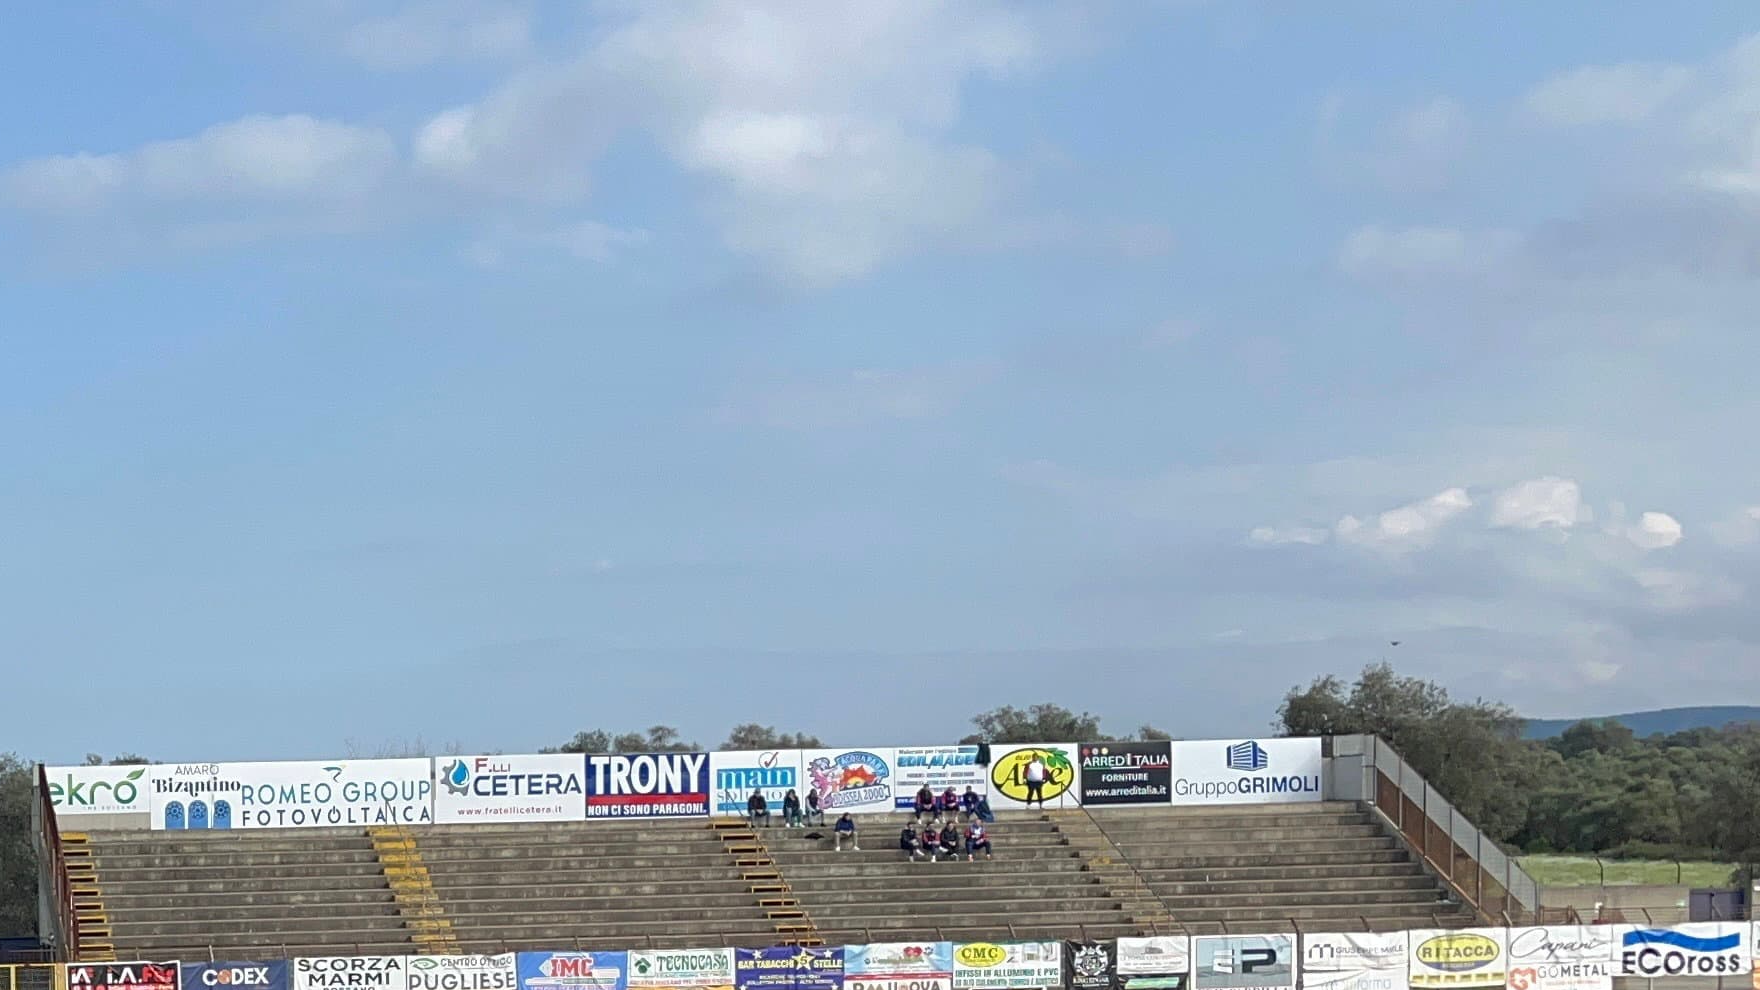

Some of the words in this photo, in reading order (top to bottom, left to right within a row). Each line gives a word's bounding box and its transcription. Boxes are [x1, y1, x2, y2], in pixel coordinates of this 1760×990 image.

[175, 765, 219, 775] AMARO
[590, 754, 706, 795] TRONY
[473, 773, 582, 796] CETERA
[718, 769, 793, 790] main
[1101, 773, 1149, 783] FORNITURE
[152, 777, 240, 797] Bizantino
[242, 782, 331, 804] ROMEO
[343, 781, 431, 803] GROUP
[1085, 786, 1167, 797] www.arreditalia.it
[243, 806, 431, 827] FOTOVOLTAICA
[588, 805, 608, 816] NON
[611, 805, 621, 816] CI
[623, 804, 651, 815] SONO
[961, 948, 998, 959] CMC
[1422, 945, 1494, 959] RITACCA
[298, 958, 401, 972] SCORZA
[440, 957, 478, 967] CENTRO
[656, 954, 728, 971] TECNOCASA
[738, 960, 753, 968] BAR
[756, 960, 794, 968] TABACCHI
[813, 960, 842, 968] STELLE
[1622, 948, 1740, 974] ECOross
[202, 967, 270, 986] CODEX
[308, 973, 390, 986] MARMI
[955, 969, 981, 977] INFISSI
[994, 968, 1034, 977] ALLUMINIO
[1044, 968, 1058, 976] PVC
[408, 971, 516, 990] PUGLIESE
